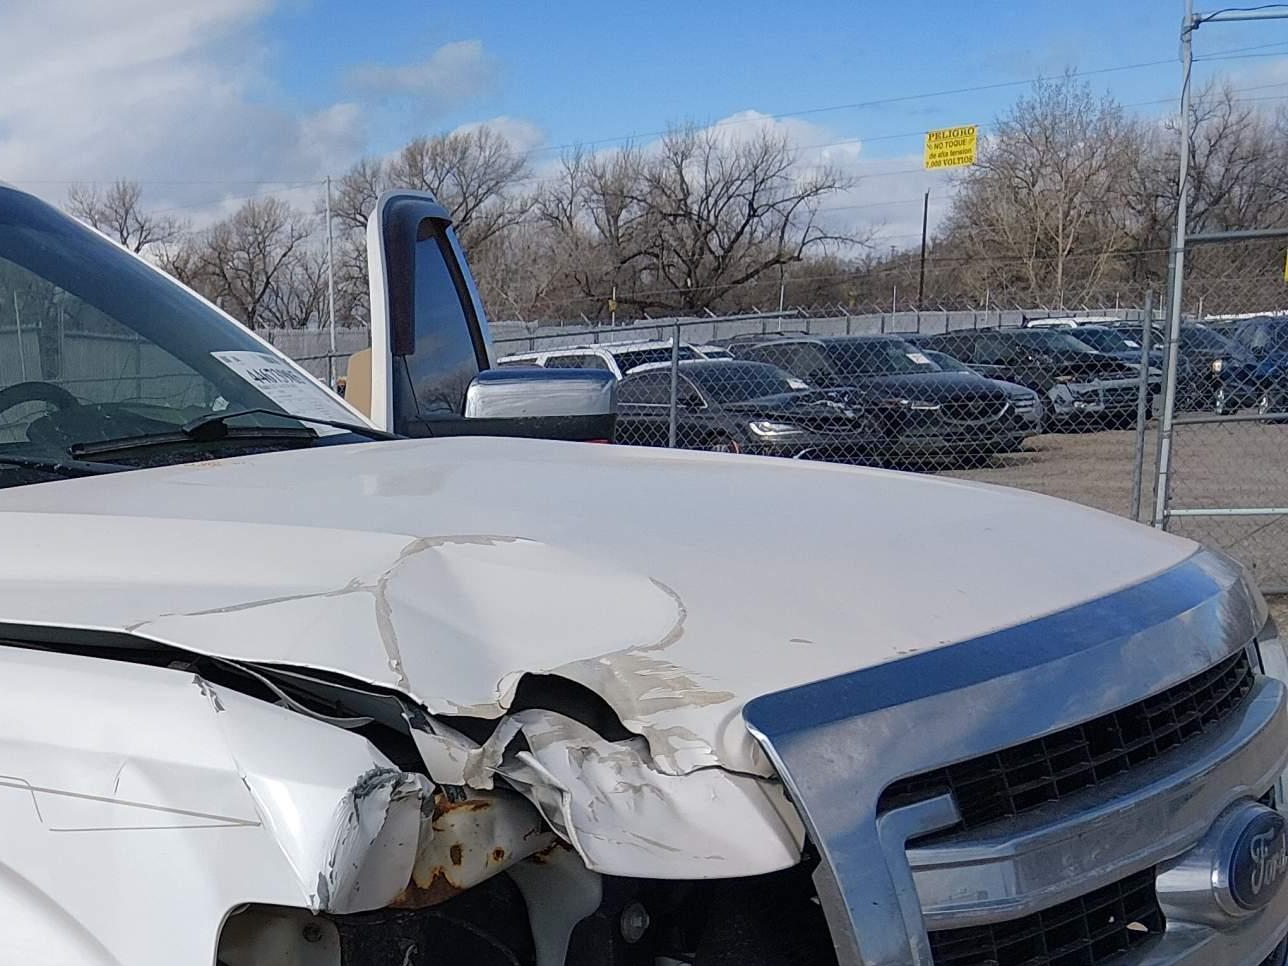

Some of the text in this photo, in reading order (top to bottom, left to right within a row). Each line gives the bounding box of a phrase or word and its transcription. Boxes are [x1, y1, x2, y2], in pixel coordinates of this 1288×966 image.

[928, 127, 975, 140] PELIGRO
[933, 140, 966, 150] NO TOQUE
[943, 156, 973, 166] VOLTIOS
